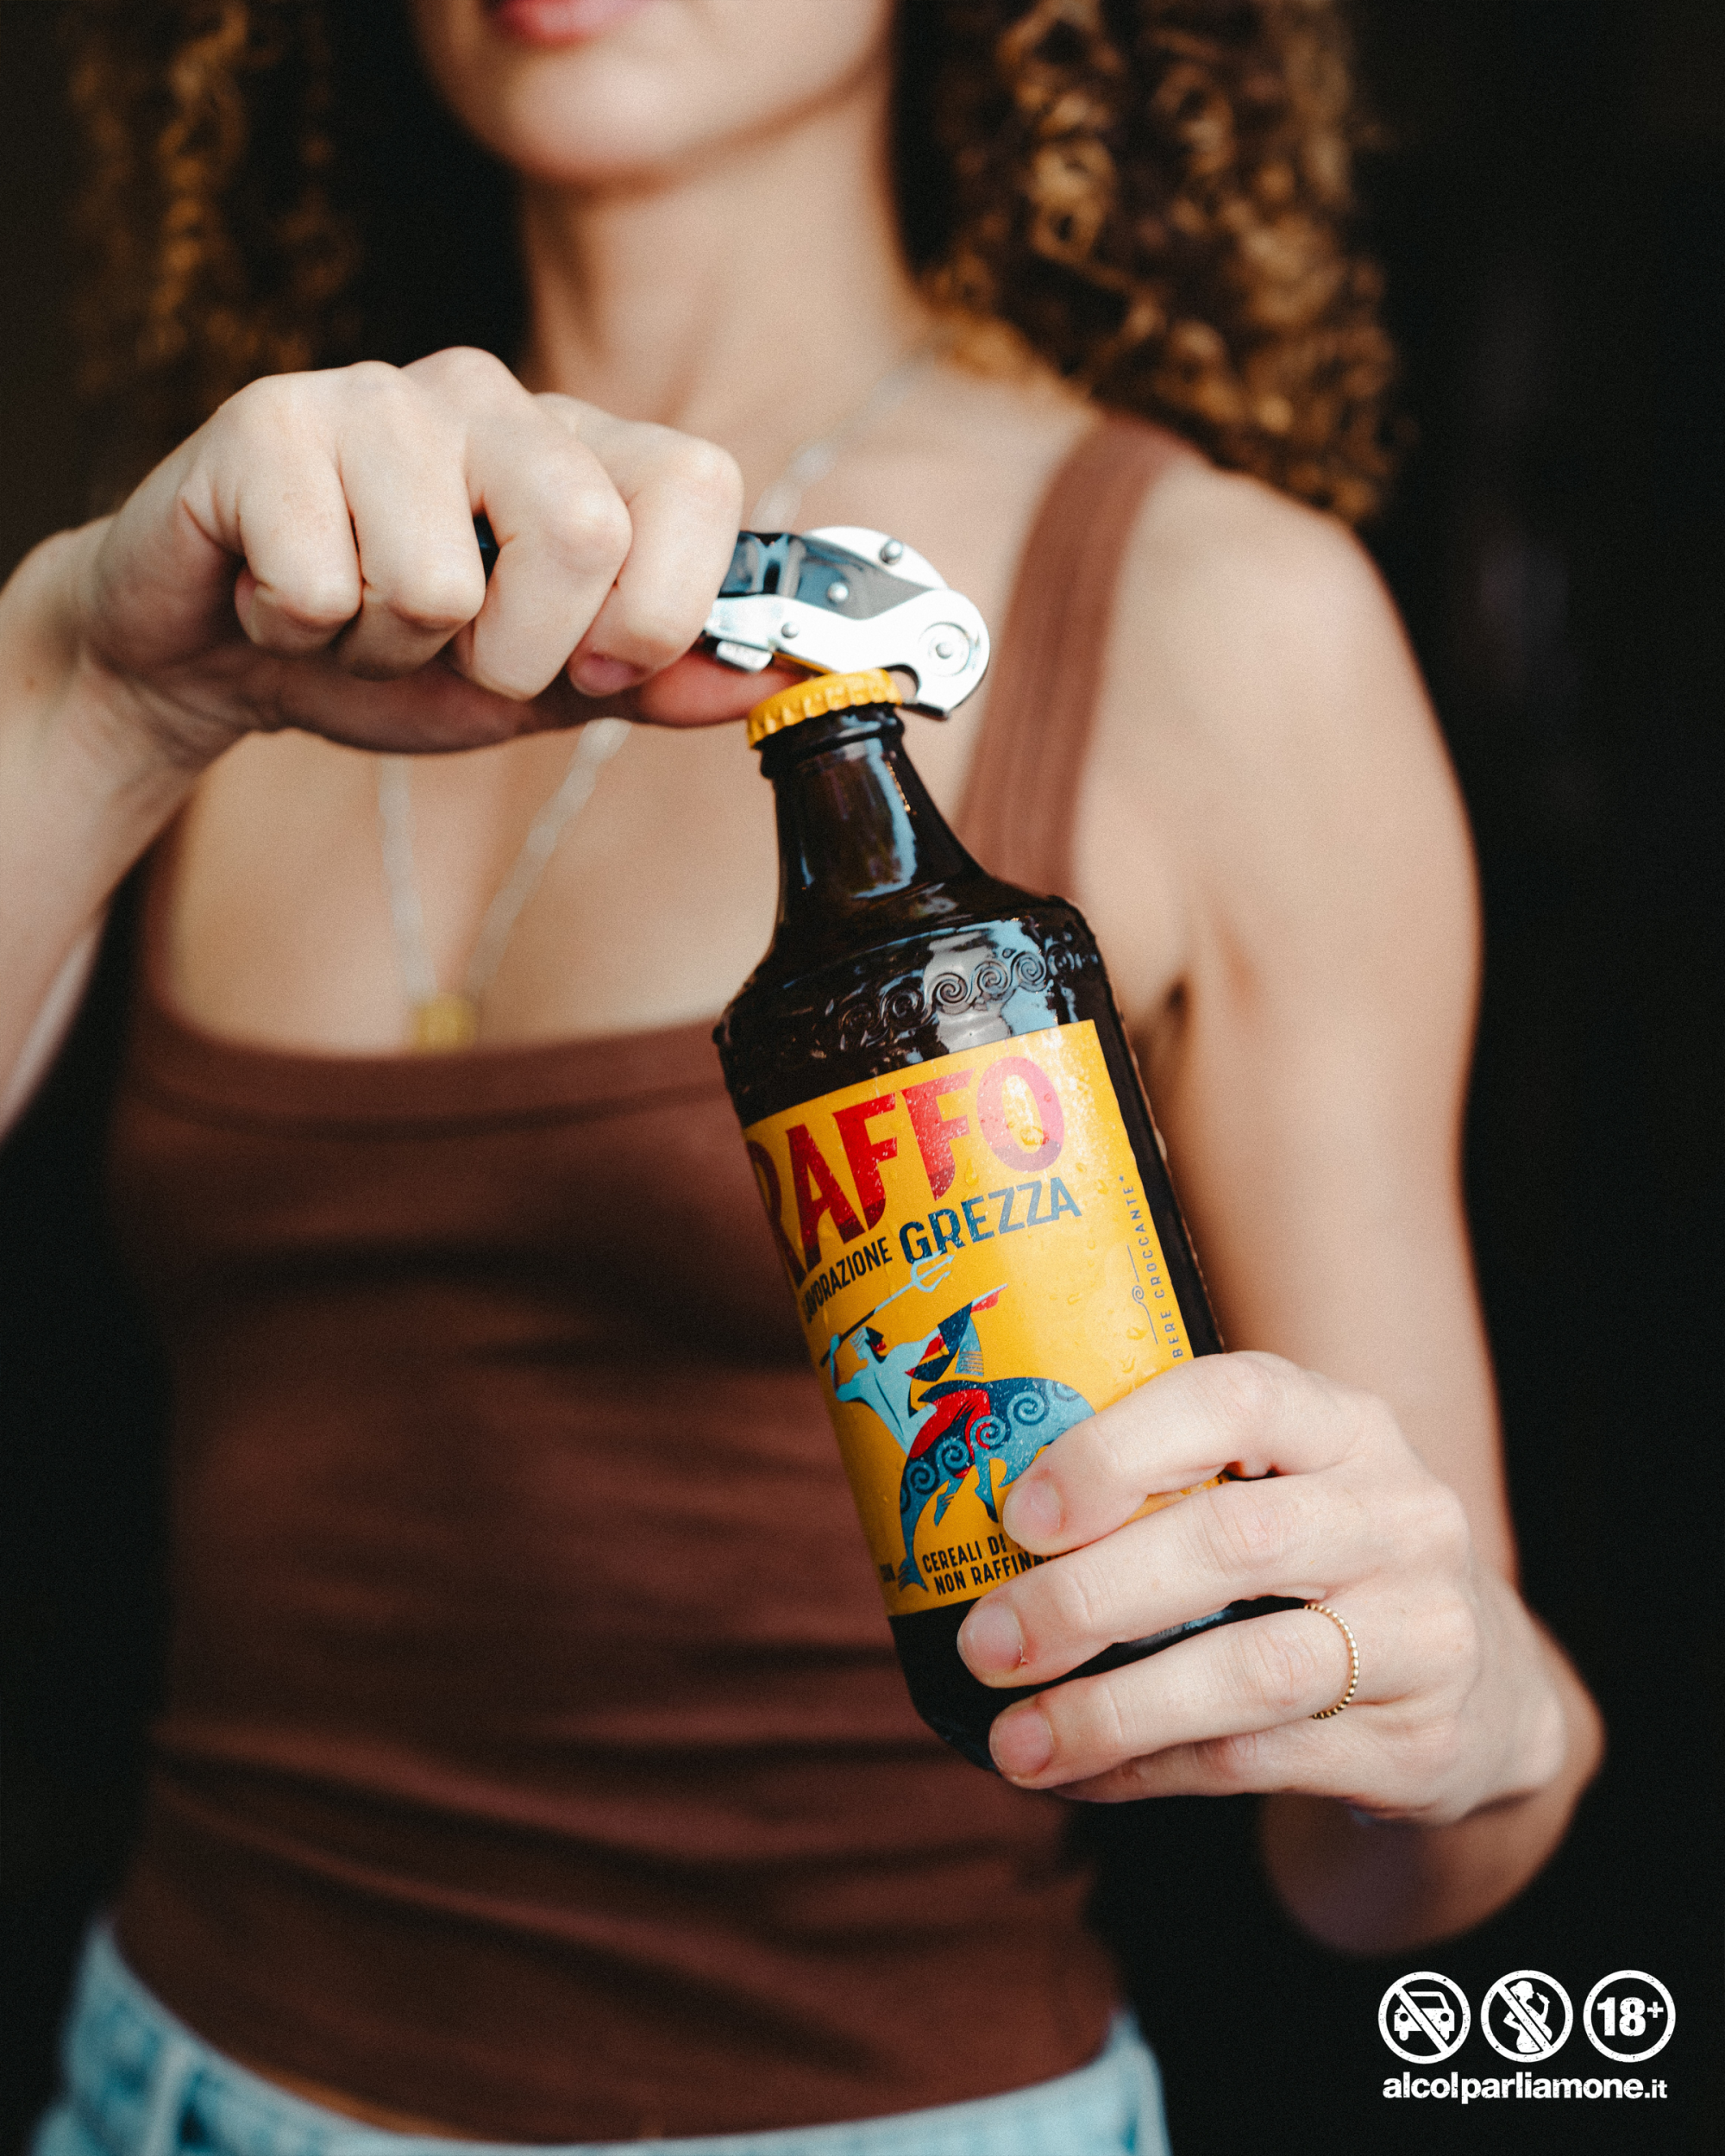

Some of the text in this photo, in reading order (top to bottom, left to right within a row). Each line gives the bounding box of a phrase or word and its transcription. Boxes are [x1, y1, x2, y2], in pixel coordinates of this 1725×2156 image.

[745, 1056, 1065, 1289] RAFFO
[899, 1176, 1082, 1264] GREZZA
[1161, 1310, 1183, 1358] BERE
[922, 1540, 982, 1573] CEREALI
[988, 1533, 1007, 1556] DI
[934, 1551, 1059, 1595] NON RAFFINA
